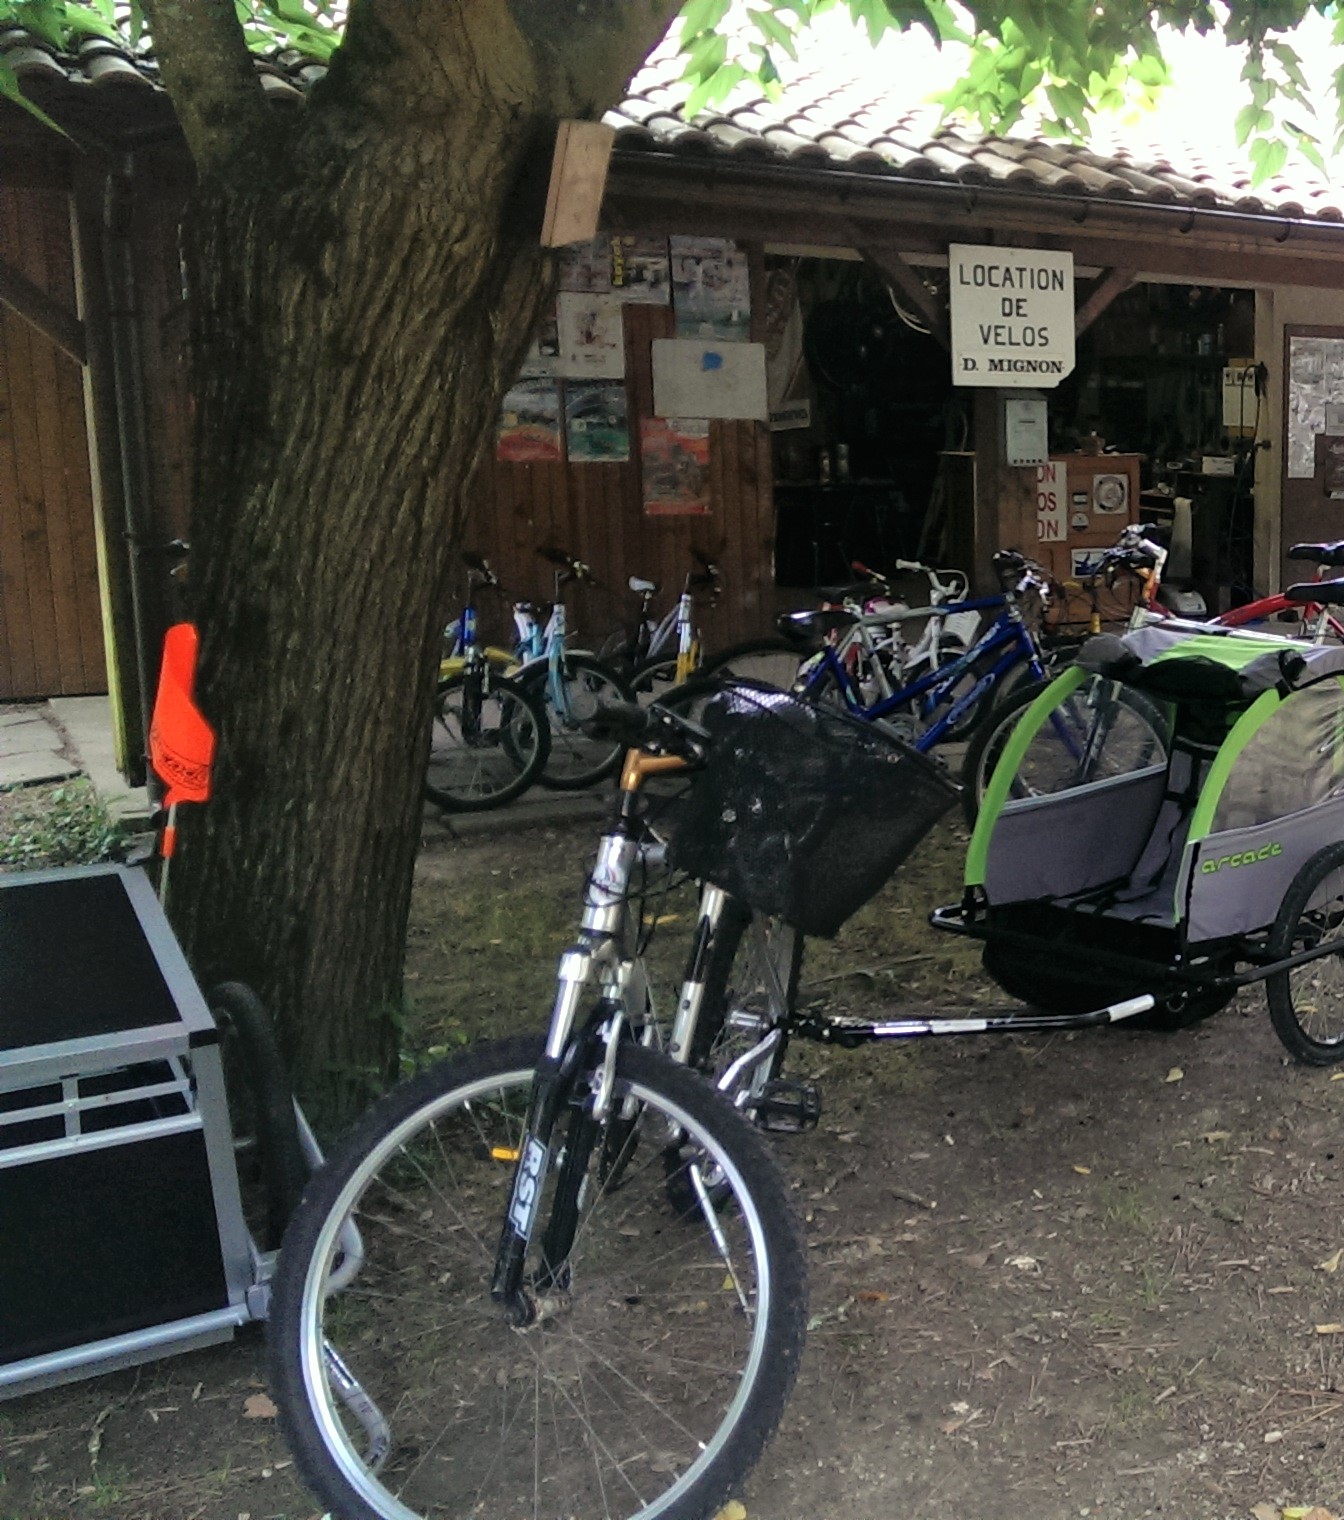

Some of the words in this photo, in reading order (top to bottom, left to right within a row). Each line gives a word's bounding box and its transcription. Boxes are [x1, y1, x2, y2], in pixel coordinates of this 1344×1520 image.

[959, 263, 1065, 291] LOCATION
[1001, 297, 1028, 318] DE
[978, 323, 1050, 347] VELOS
[962, 357, 979, 371] D.
[987, 358, 1064, 374] MIGNON
[1201, 842, 1283, 873] arcade
[511, 1139, 545, 1235] RST
